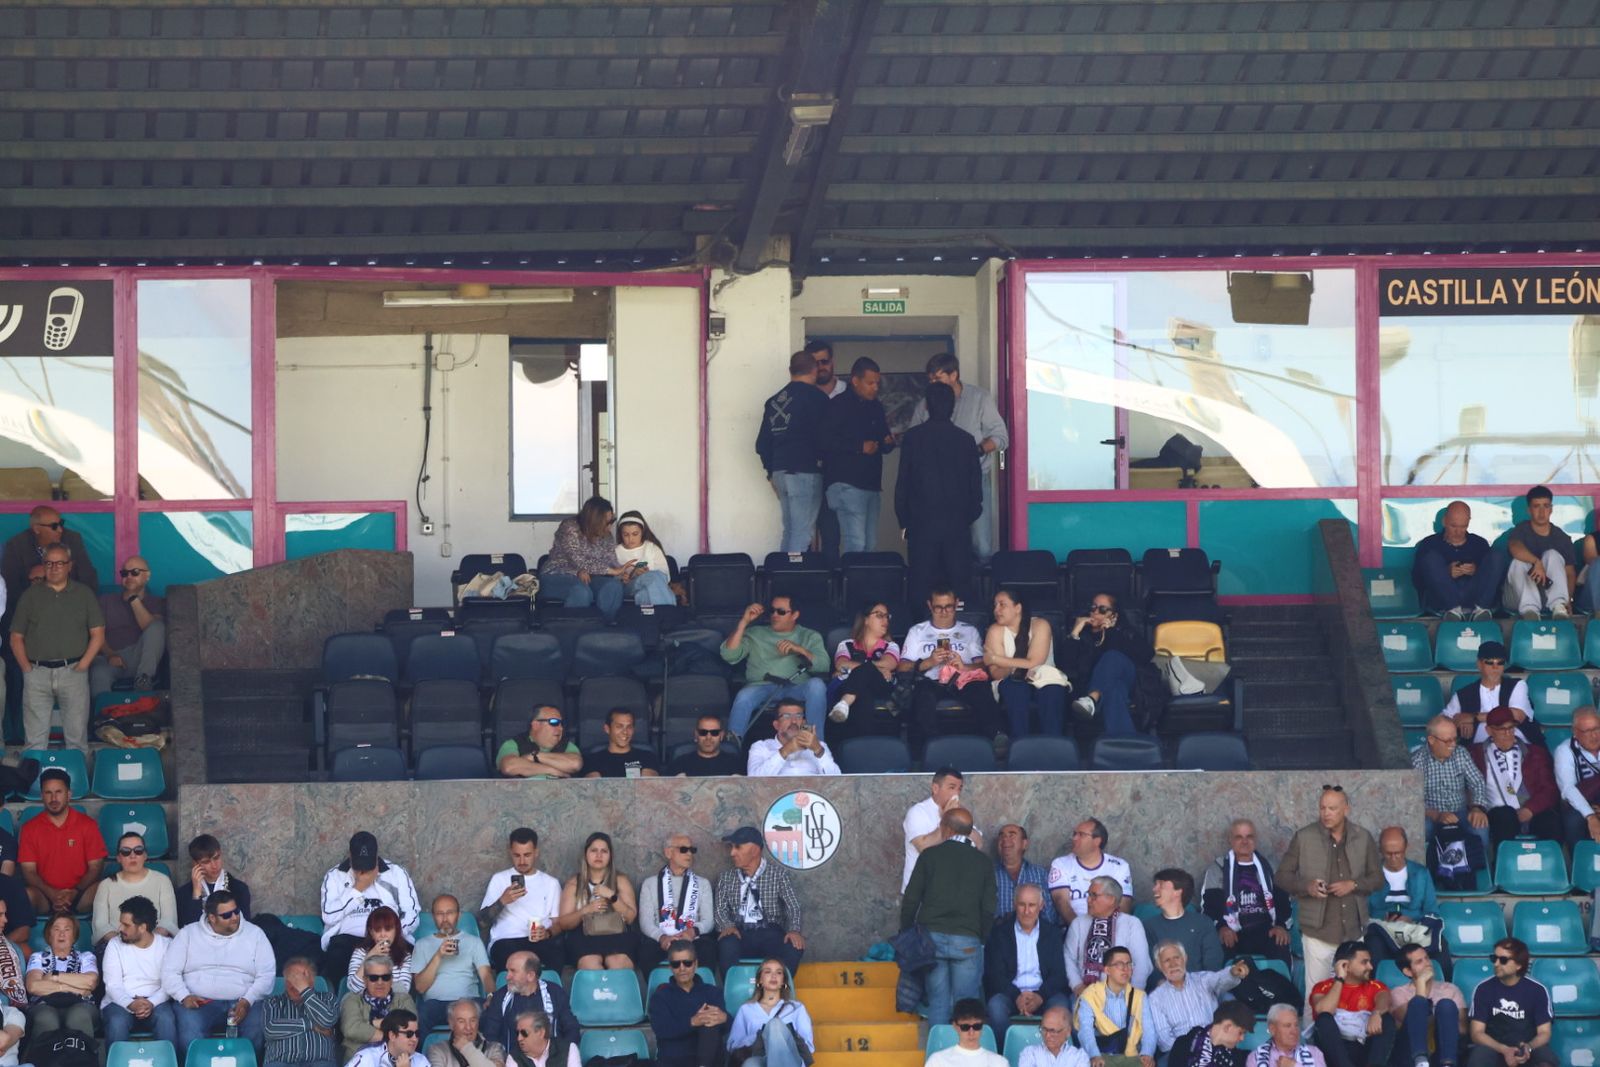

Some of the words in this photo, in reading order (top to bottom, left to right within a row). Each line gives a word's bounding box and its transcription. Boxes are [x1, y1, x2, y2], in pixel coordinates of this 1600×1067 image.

[1387, 279, 1508, 305] CASTILLA
[1512, 278, 1528, 304] Y
[1536, 271, 1600, 304] LEÓN
[864, 302, 903, 313] SALIDA
